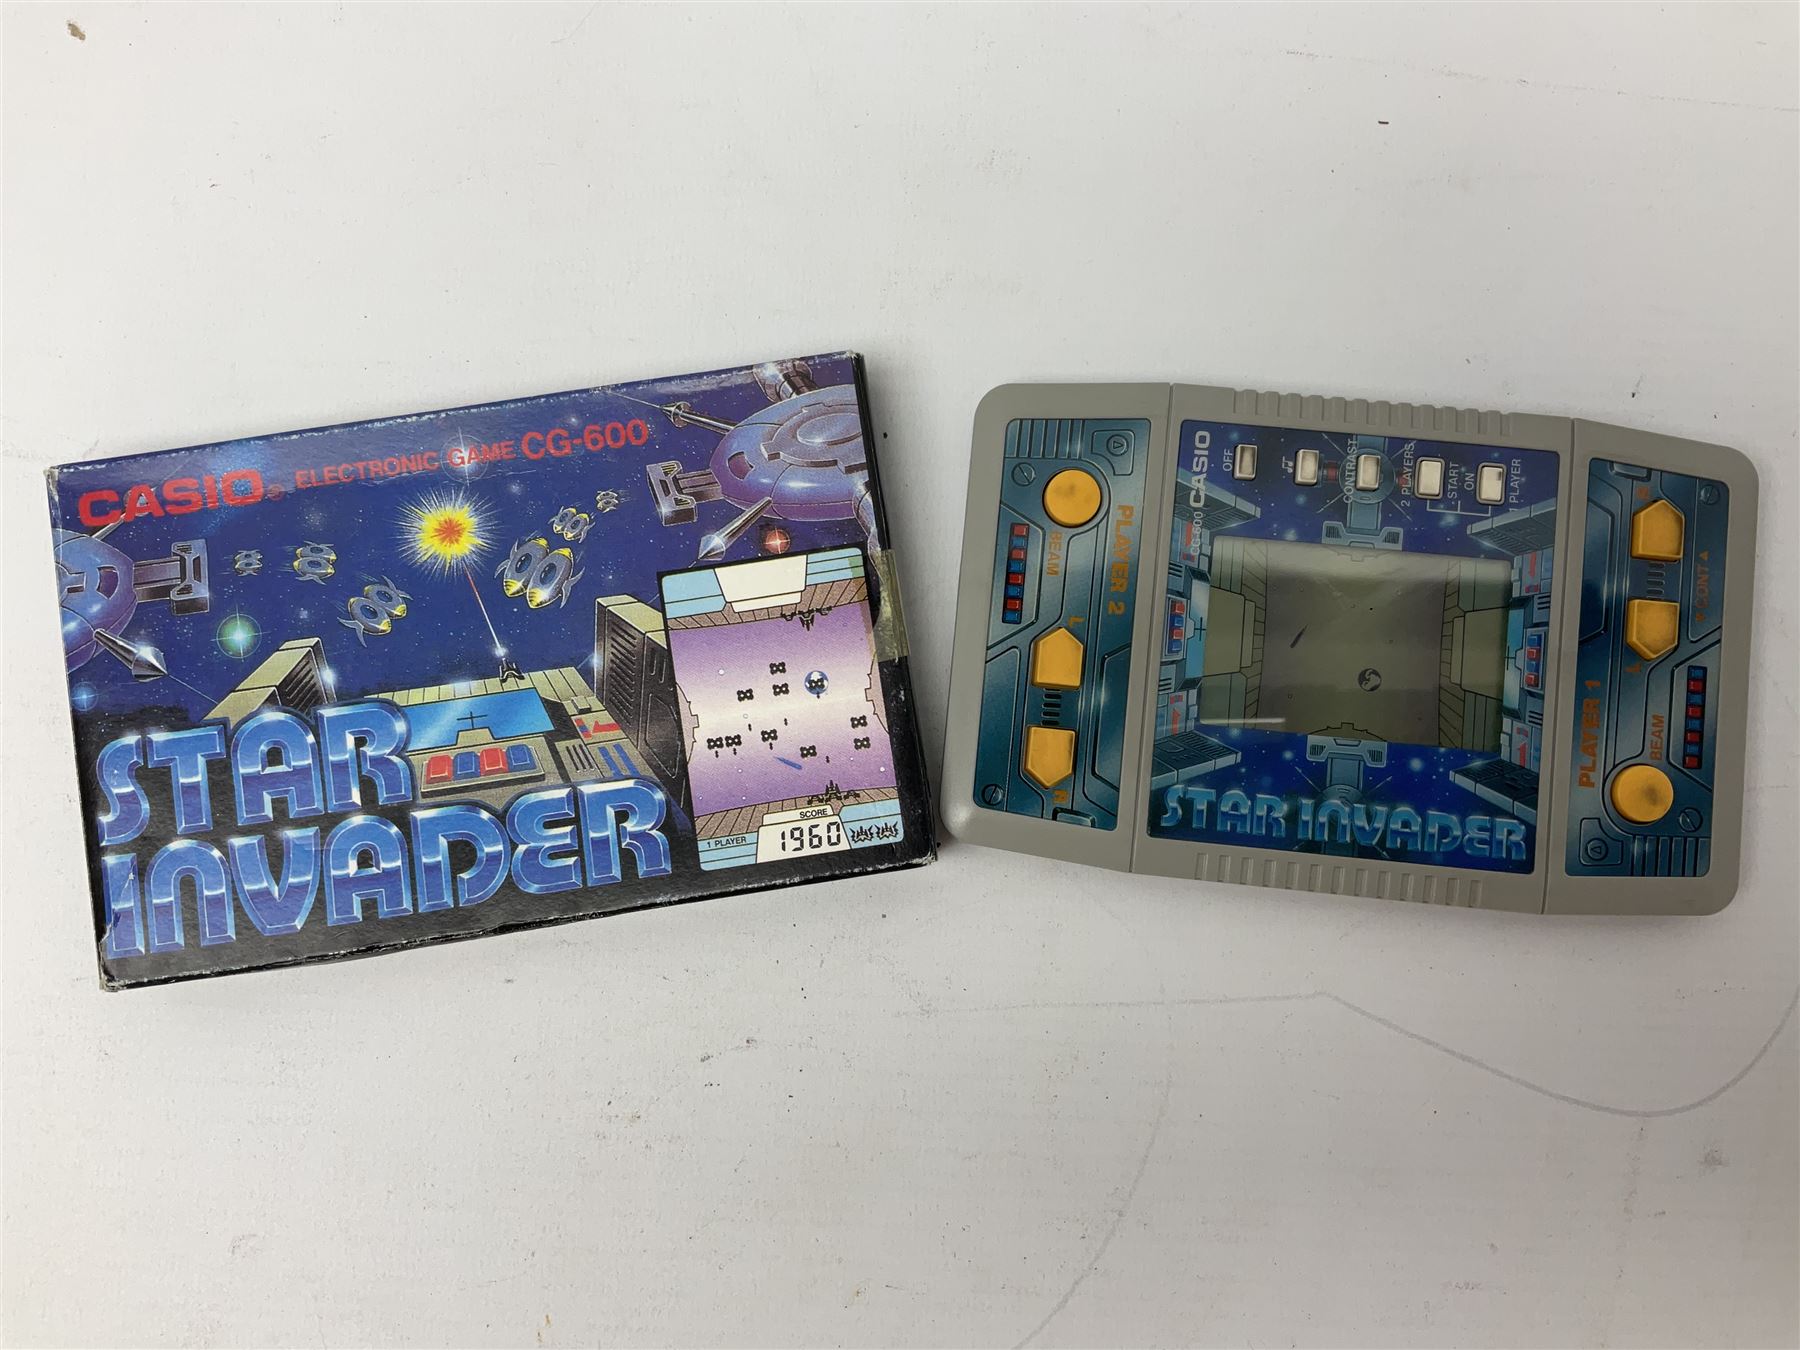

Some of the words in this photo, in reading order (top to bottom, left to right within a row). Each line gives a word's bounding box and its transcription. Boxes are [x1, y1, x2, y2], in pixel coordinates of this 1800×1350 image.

[295, 451, 440, 489] ELECTRONIC
[448, 439, 517, 467] GAME
[521, 418, 649, 461] CG-600
[1190, 430, 1211, 508] CASIO
[1222, 448, 1233, 472] OFF
[1343, 439, 1358, 503] CONTRAST
[1401, 442, 1416, 496] PLAYERS
[78, 468, 264, 527] CASIO
[1447, 461, 1460, 499] START
[1464, 472, 1475, 491] ON
[1509, 458, 1522, 504] PLAYER
[1401, 500, 1411, 508] 2
[1046, 531, 1064, 577] BEAM
[1110, 504, 1135, 593] PLAYER
[1190, 511, 1204, 556] CG-600
[1107, 601, 1125, 615] 2
[1584, 680, 1601, 689] 1
[1578, 700, 1601, 788] PLAYER
[1650, 714, 1665, 761] BEAM
[96, 700, 413, 846] STAR
[780, 821, 842, 852] 1960
[799, 808, 828, 819] SCORE
[1160, 784, 1288, 838] STAR
[1297, 798, 1527, 860] INVADER
[707, 841, 711, 849] 1
[714, 835, 747, 848] PLAYER
[101, 777, 673, 959] INVADER
